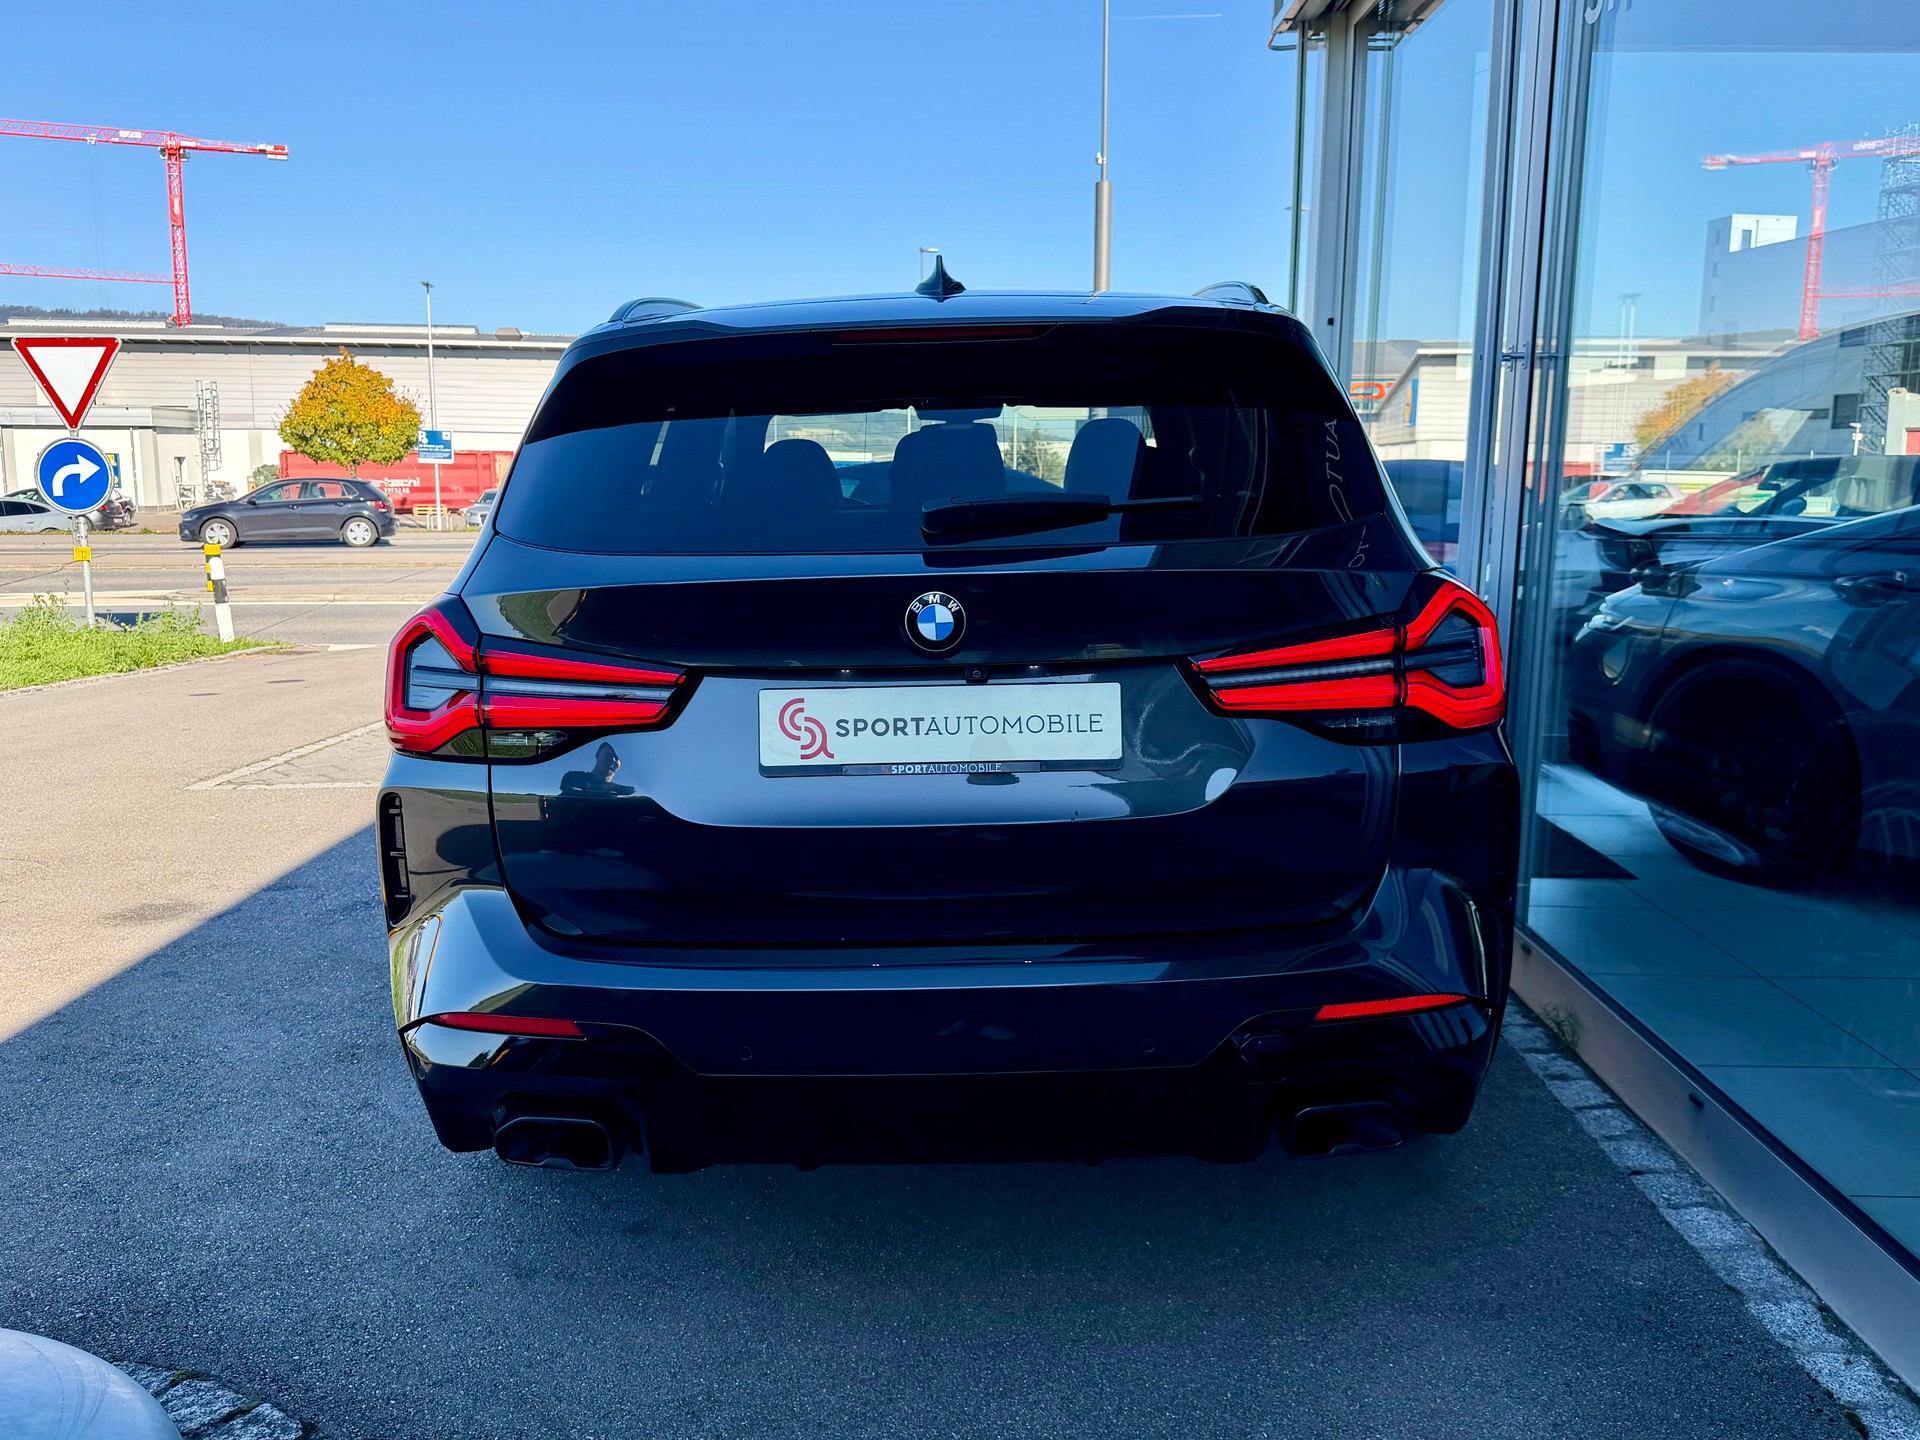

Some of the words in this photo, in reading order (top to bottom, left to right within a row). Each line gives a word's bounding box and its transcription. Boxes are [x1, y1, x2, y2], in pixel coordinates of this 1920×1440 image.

[911, 594, 960, 614] BMW
[835, 713, 1103, 738] SPORTAUTOMOBILE
[891, 763, 1002, 774] SPORTAUTOMOBILE
